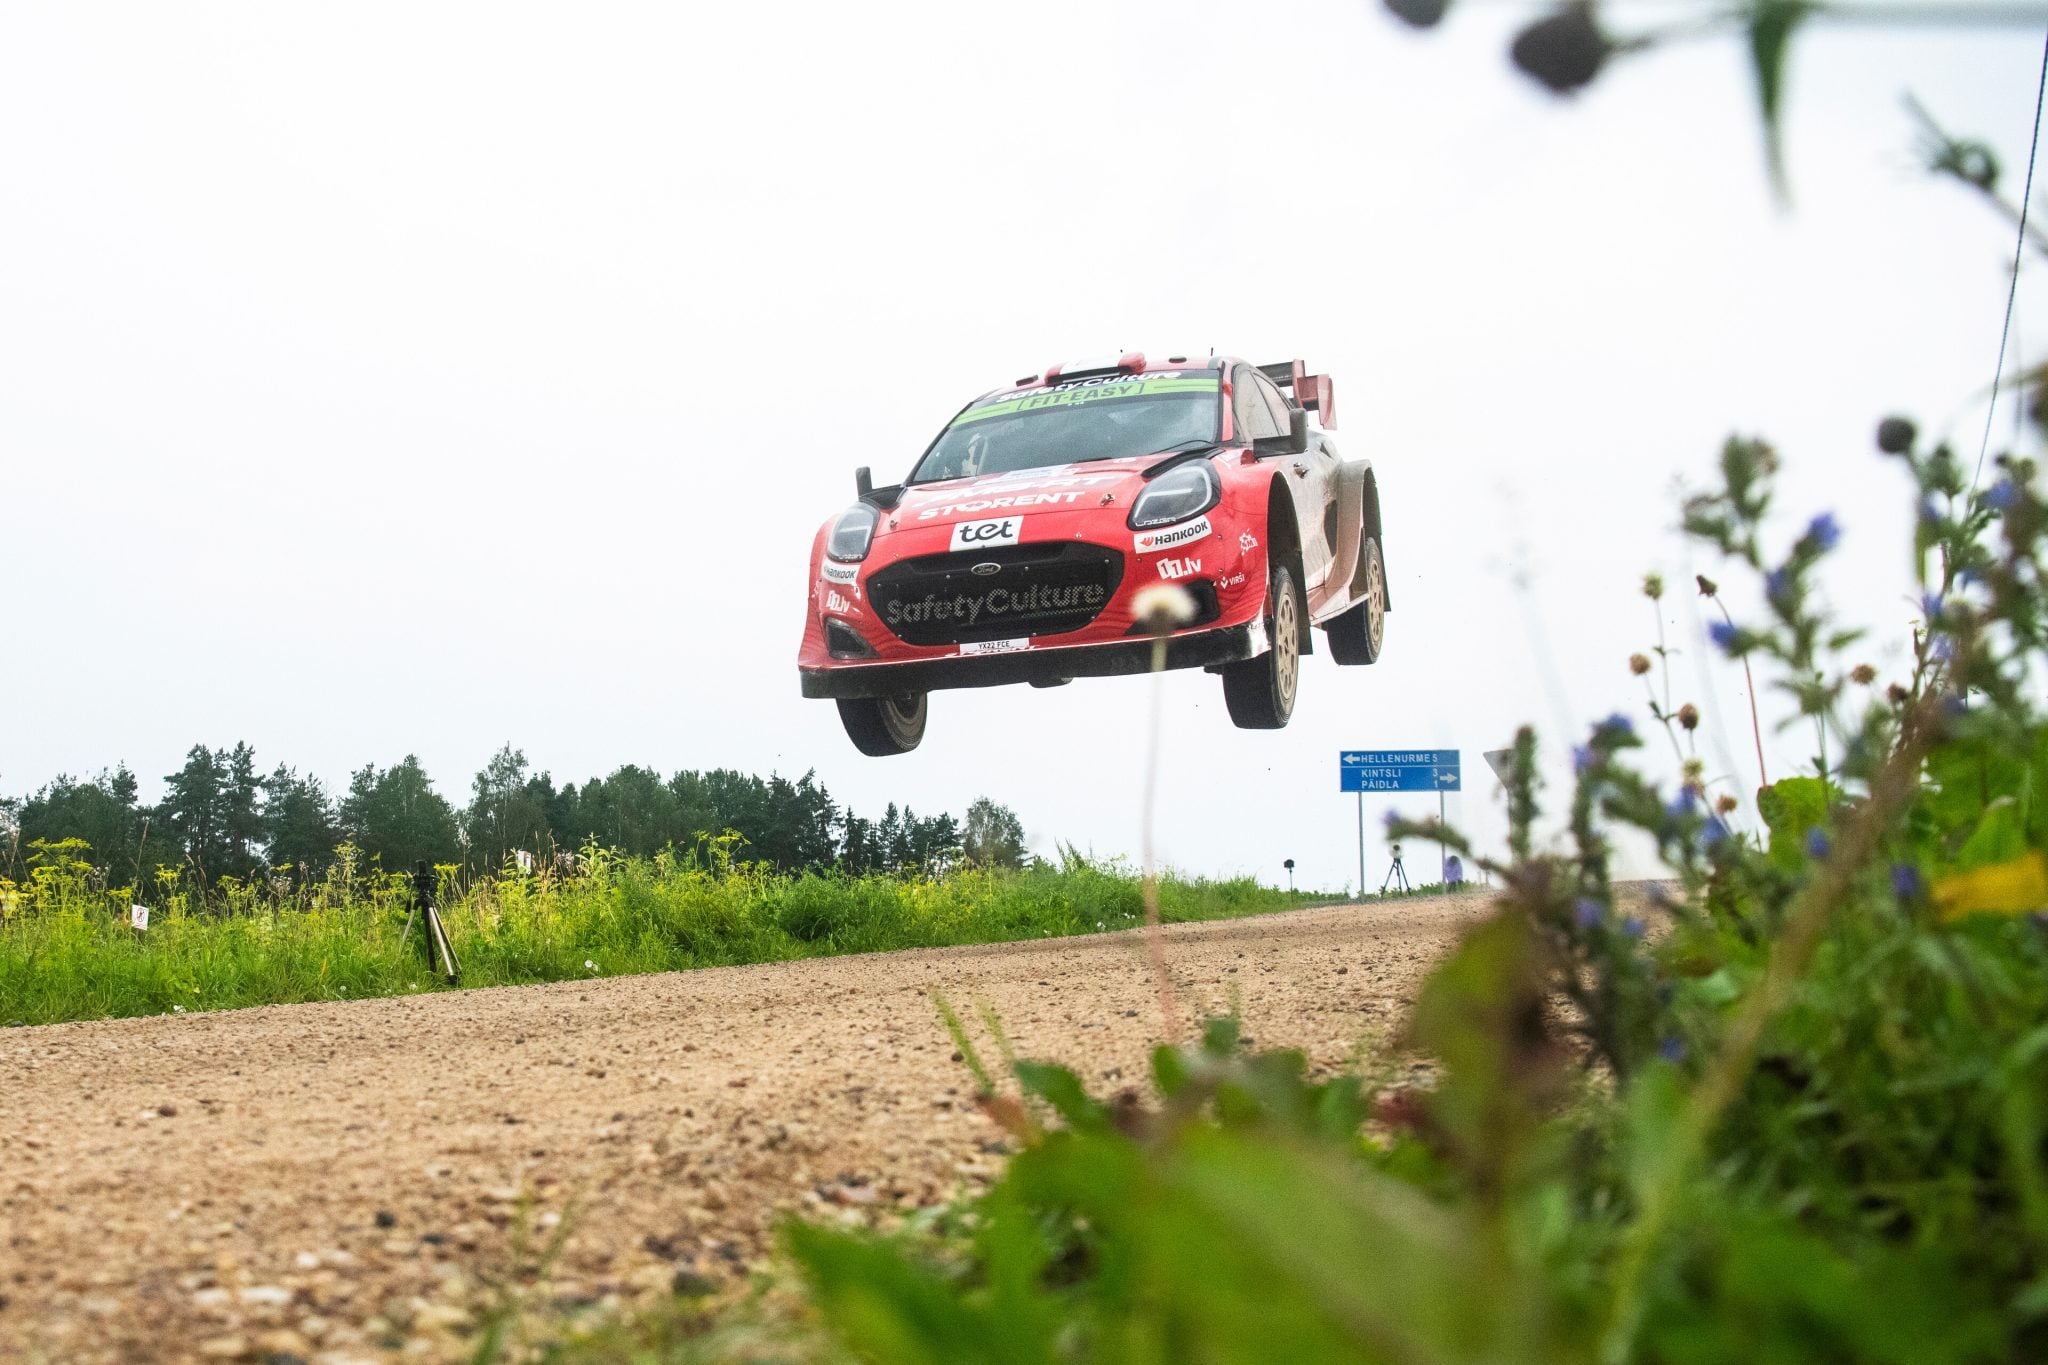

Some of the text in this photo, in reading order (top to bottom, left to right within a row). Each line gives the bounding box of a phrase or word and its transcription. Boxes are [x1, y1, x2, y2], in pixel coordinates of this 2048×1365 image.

[917, 491, 1085, 520] STORENT
[959, 520, 1013, 543] tet
[887, 584, 1104, 624] SafetyCulture
[1361, 754, 1438, 763] HELLENURME 5
[1361, 768, 1438, 778] KINTSLI 3
[1361, 779, 1399, 789] PÄIDLA
